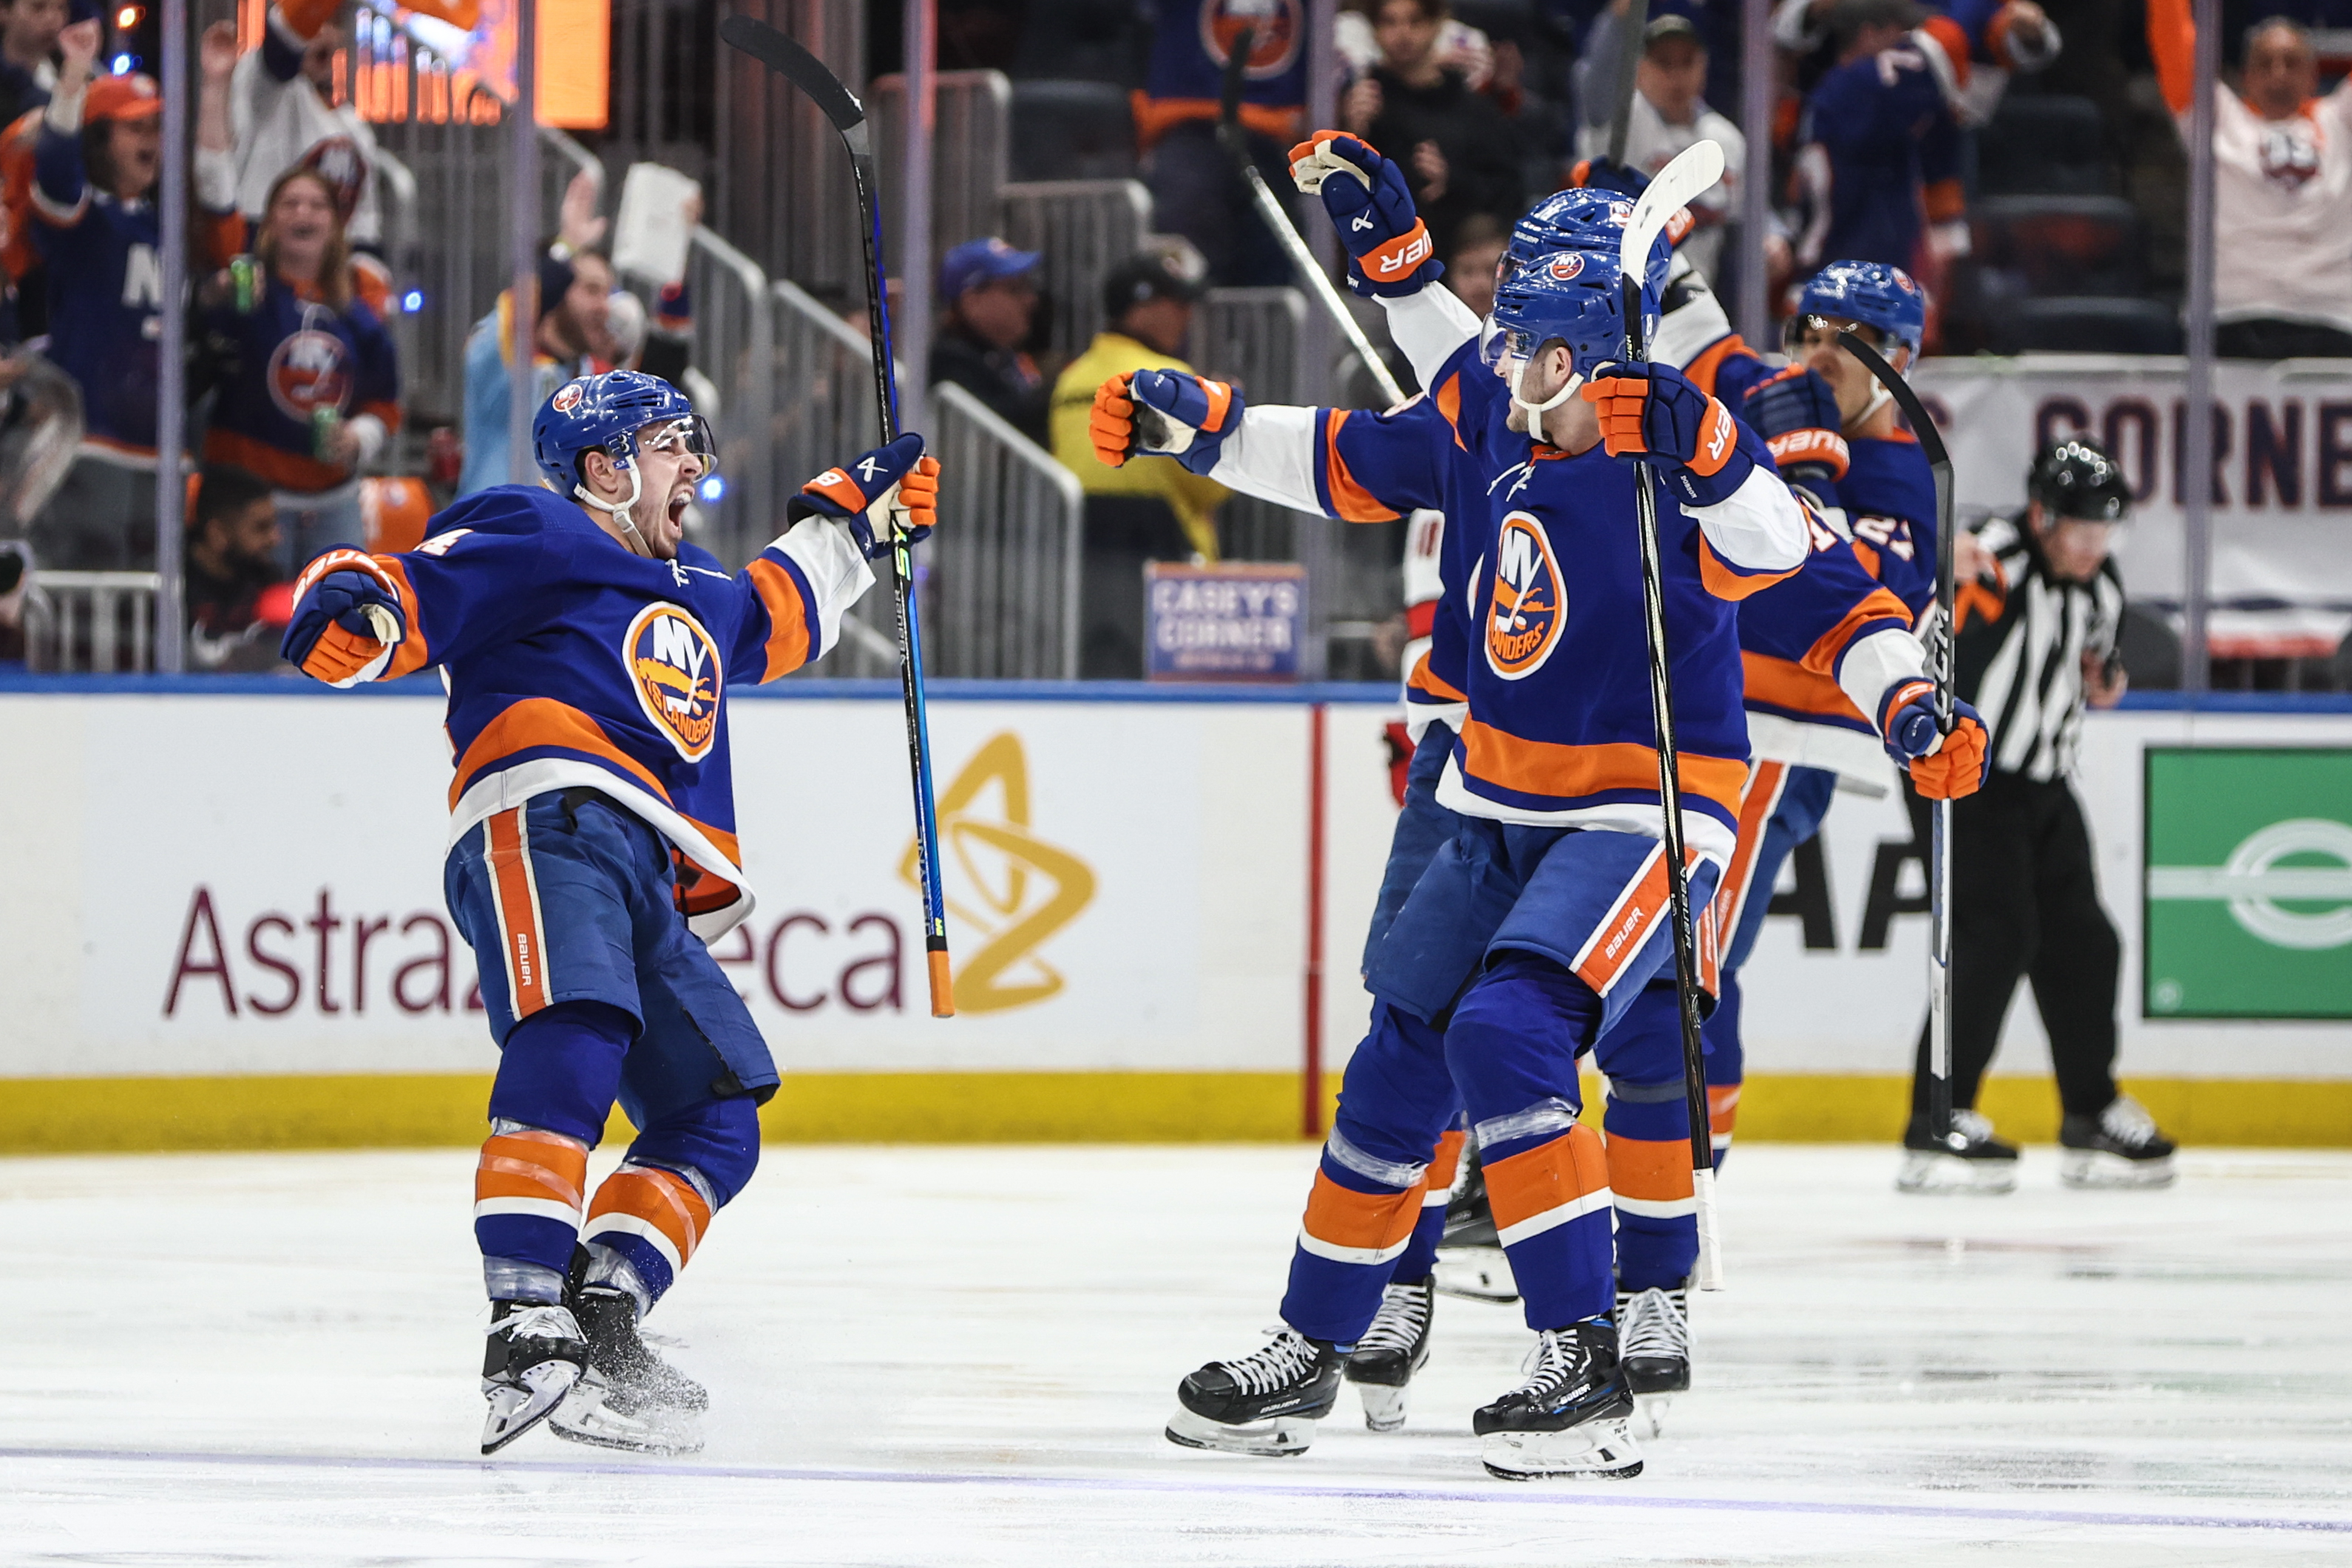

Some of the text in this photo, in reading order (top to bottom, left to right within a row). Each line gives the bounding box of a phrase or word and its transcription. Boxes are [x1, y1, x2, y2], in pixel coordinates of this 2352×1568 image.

[1681, 475, 1698, 499] DOBSON
[1491, 621, 1545, 660] ANDERS
[1604, 906, 1645, 960] BAUER
[517, 932, 532, 987] BAUER
